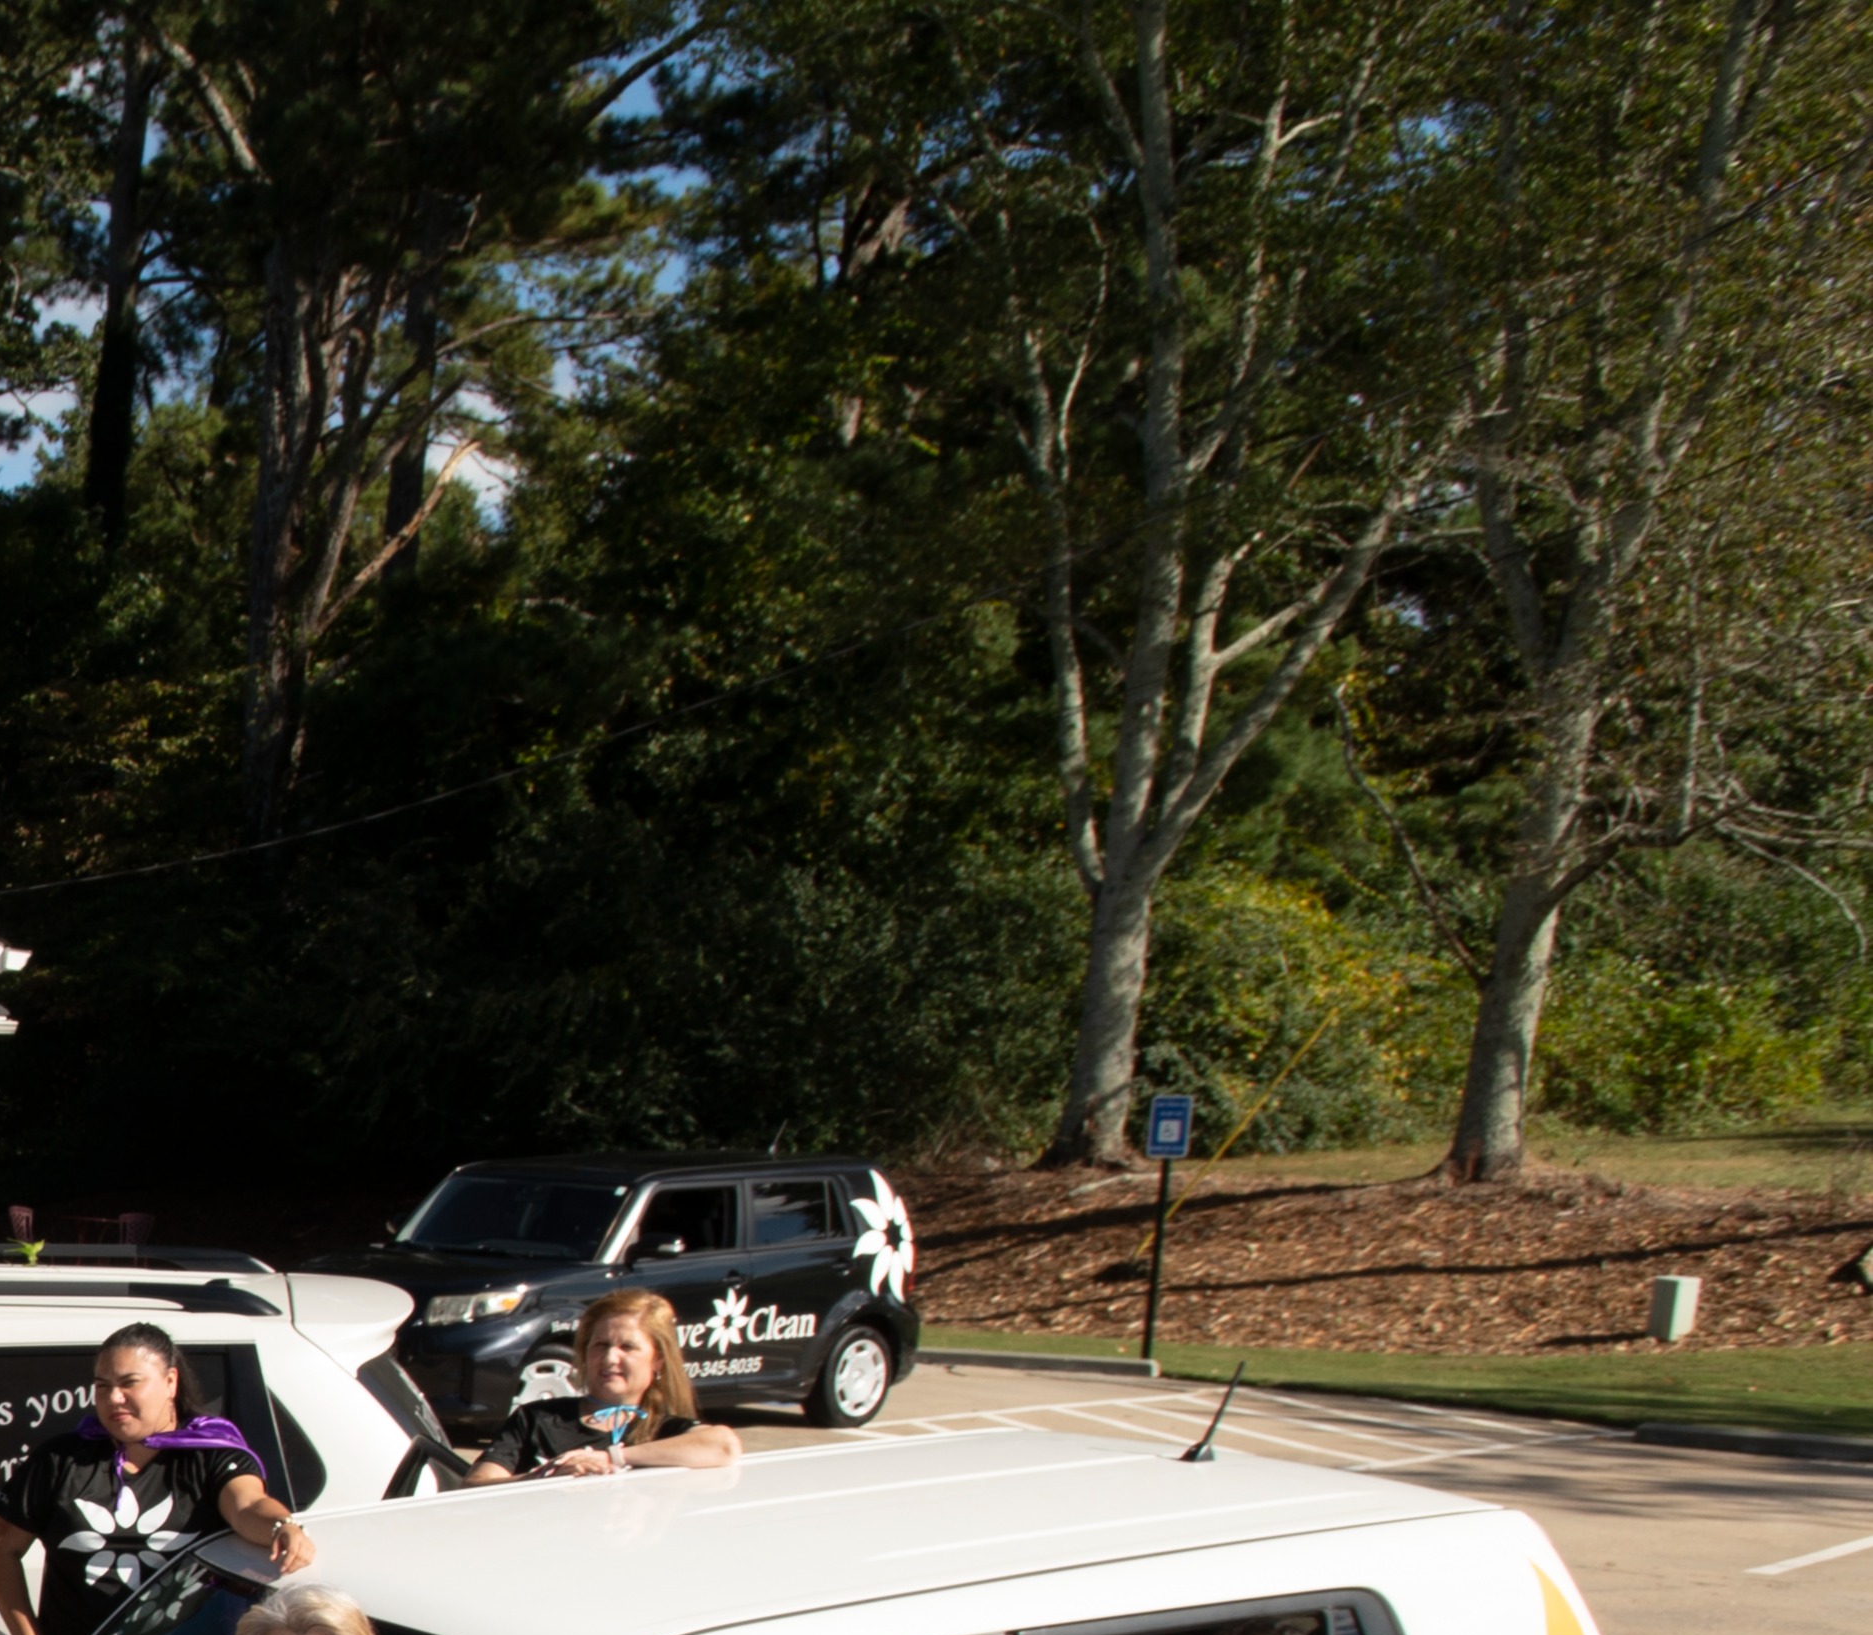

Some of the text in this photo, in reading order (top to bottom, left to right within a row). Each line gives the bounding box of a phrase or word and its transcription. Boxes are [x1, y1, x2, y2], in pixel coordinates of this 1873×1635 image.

[746, 1304, 816, 1343] Clean
[683, 1355, 764, 1379] 70-345-8035
[26, 1383, 97, 1428] you
